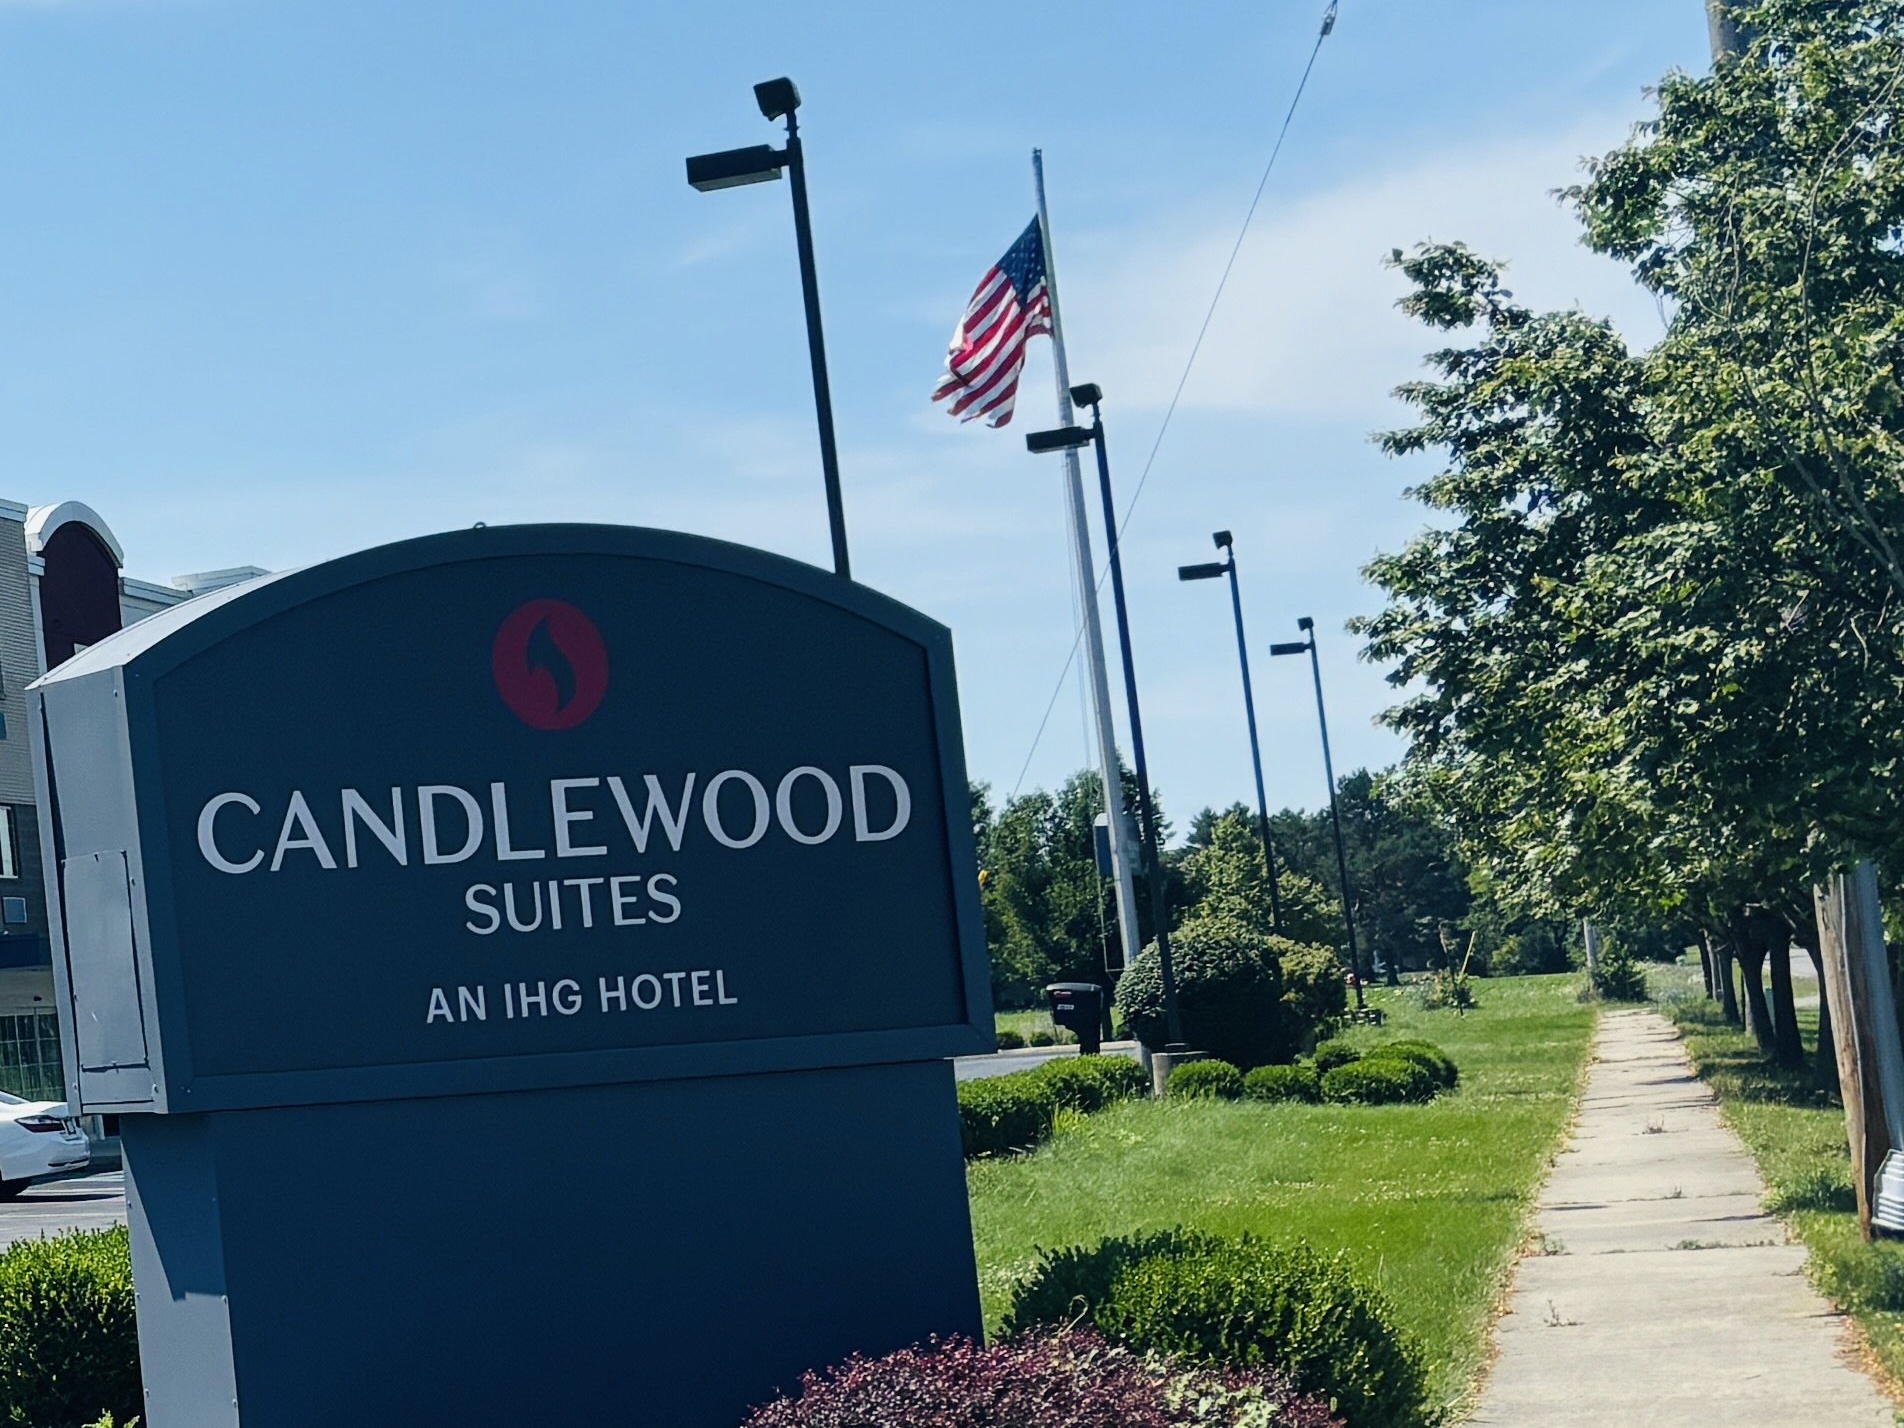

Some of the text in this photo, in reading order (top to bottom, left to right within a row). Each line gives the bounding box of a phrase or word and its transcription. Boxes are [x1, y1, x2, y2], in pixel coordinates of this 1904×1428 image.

[197, 764, 912, 874] CANDLEWOOD
[465, 873, 682, 935] SUITES
[426, 969, 738, 1024] AN IHG HOTEL
